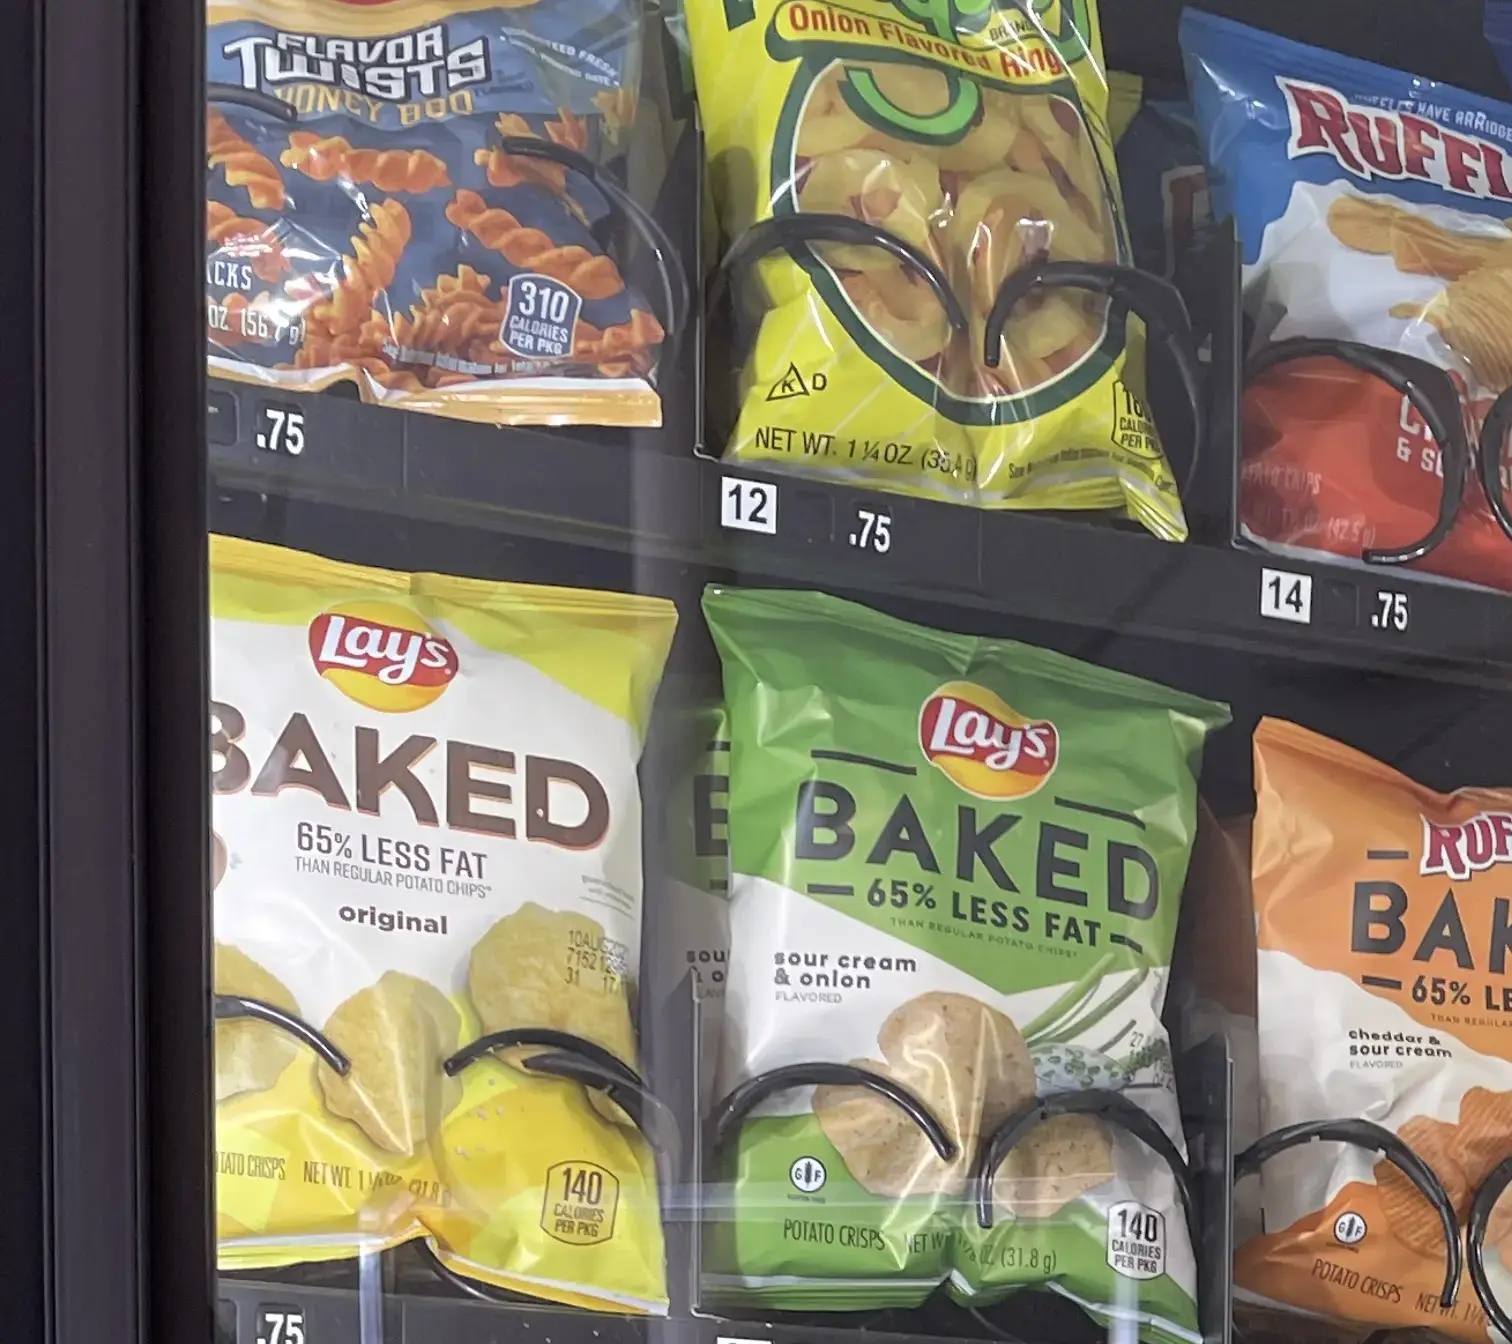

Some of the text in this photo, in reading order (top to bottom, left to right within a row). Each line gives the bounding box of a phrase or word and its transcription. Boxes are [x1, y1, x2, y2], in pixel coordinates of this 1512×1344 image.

[277, 27, 443, 64] FLAVOR
[789, 3, 870, 36] Onion
[881, 22, 990, 72] Flavored
[225, 37, 487, 99] TWISTS
[275, 88, 473, 127] HONEY BBQ
[1418, 102, 1450, 122] HAVE
[519, 281, 569, 324] 310
[509, 316, 568, 343] CALORIES
[509, 330, 562, 354] PER PKG
[257, 409, 304, 455] .75
[755, 430, 913, 465] NET WT. OZ
[727, 486, 768, 524] 12
[849, 510, 891, 553] .75
[1268, 577, 1301, 614] 14
[1371, 593, 1408, 631] .75
[319, 616, 450, 685] Lay's
[930, 699, 1049, 769] Lay's
[211, 701, 609, 850] BAKED
[297, 822, 487, 879] 65% LESS FAT
[794, 781, 1159, 921] BAKED
[295, 856, 329, 876] THAN
[333, 860, 392, 887] REGULAR
[396, 873, 443, 893] POTATO
[339, 905, 447, 935] original
[867, 879, 1100, 946] 65% LESS FAT
[774, 952, 917, 972] sour cream
[774, 968, 870, 989] & onion
[775, 992, 842, 1003] FLAVORED
[1412, 975, 1471, 1006] 65%
[1349, 1028, 1421, 1044] cheddar
[1350, 1045, 1451, 1058] sour cream
[246, 1155, 285, 1181] CRISPS
[563, 1167, 602, 1204] 140
[555, 1220, 598, 1237] PER PKG
[784, 1219, 885, 1251] POTATO CRISPS
[1118, 1210, 1157, 1241] 140
[1112, 1239, 1161, 1260] CALORIES
[1114, 1255, 1157, 1274] PER PKG
[1312, 1259, 1404, 1303] POTATO CRISPS
